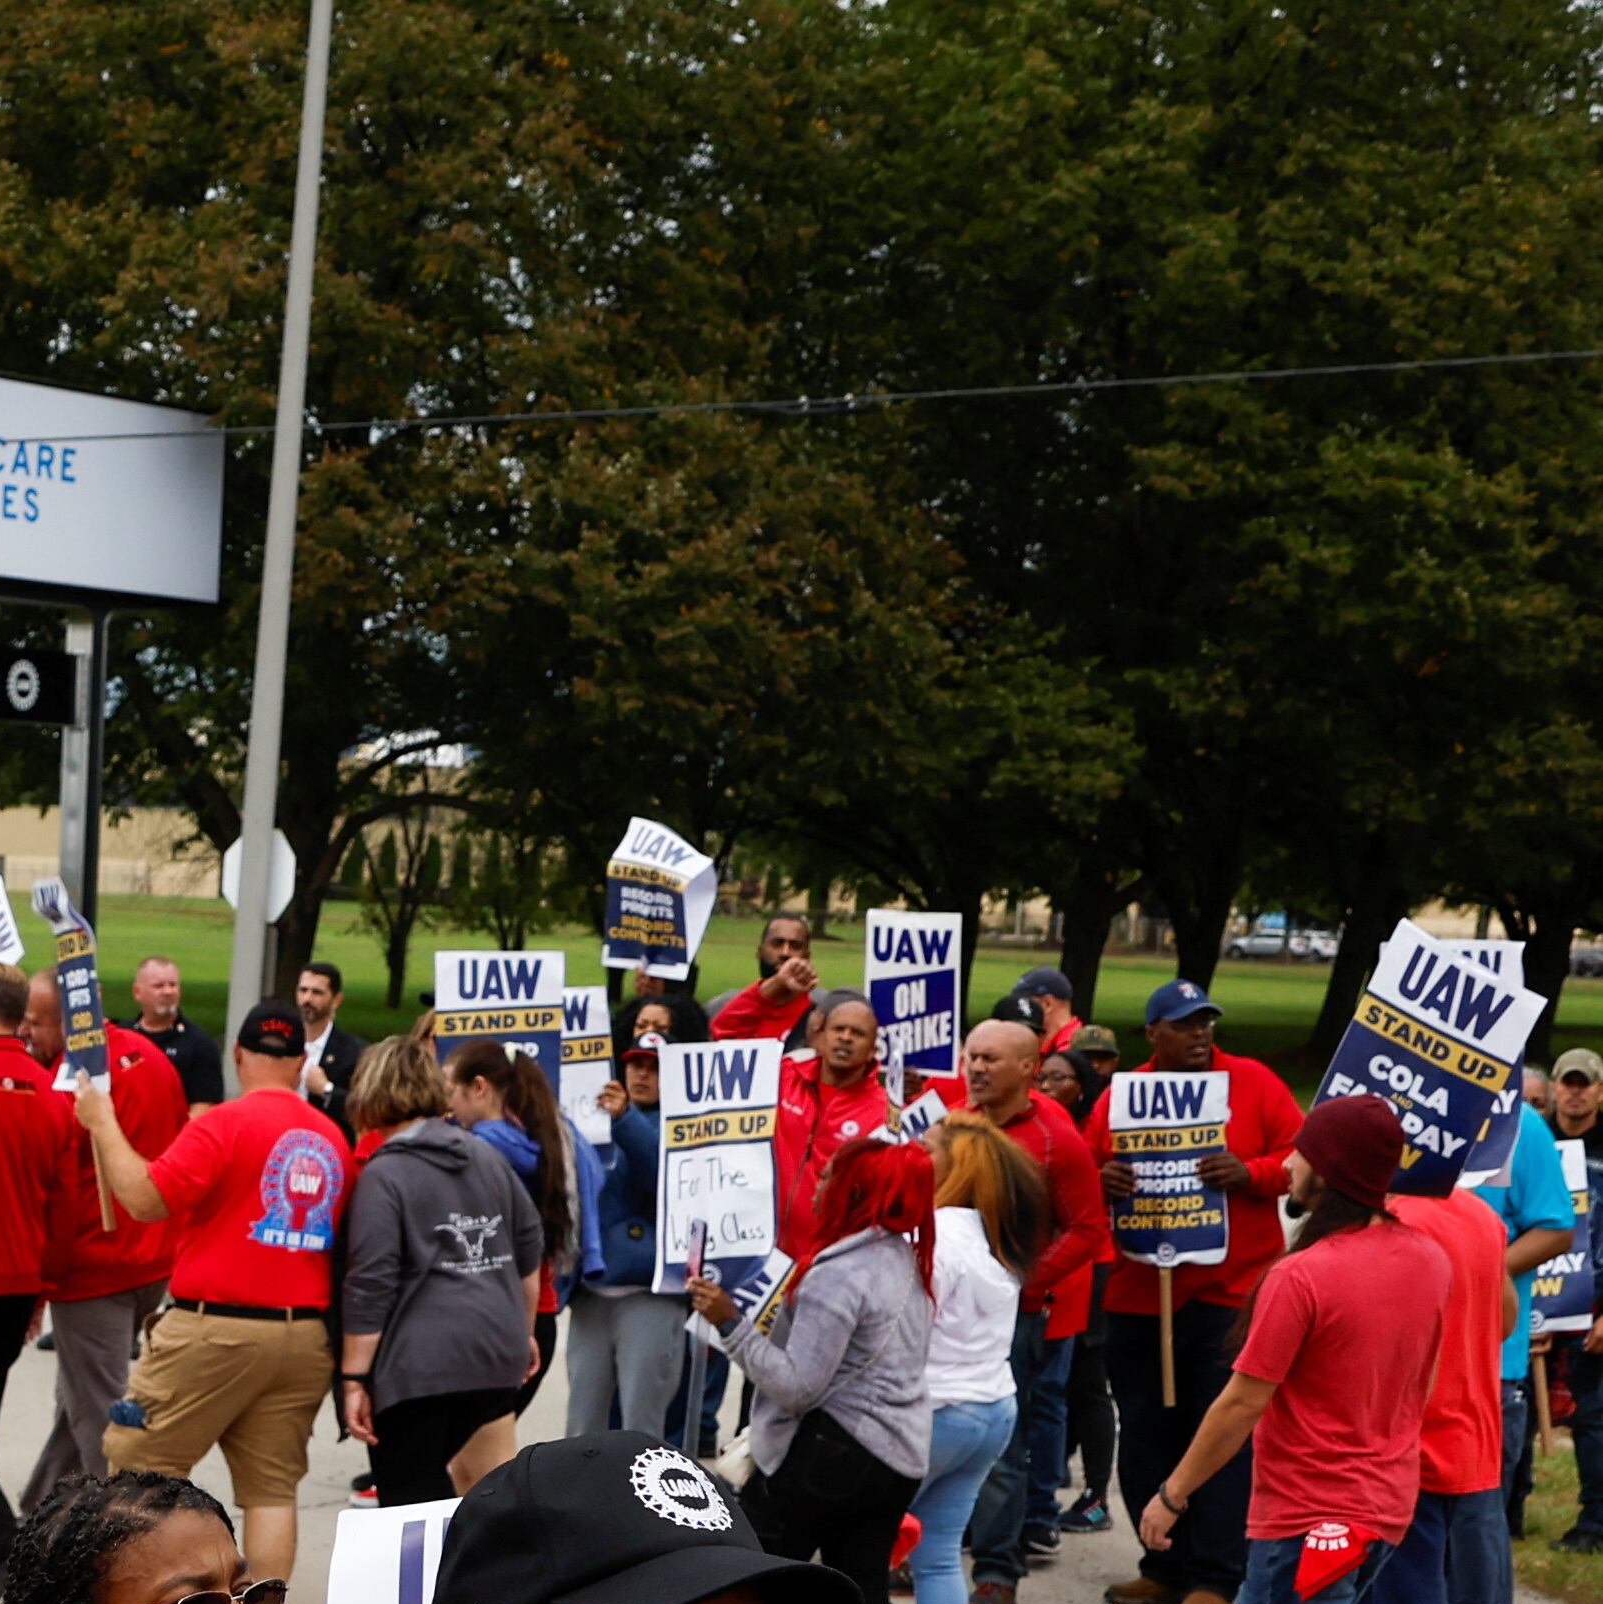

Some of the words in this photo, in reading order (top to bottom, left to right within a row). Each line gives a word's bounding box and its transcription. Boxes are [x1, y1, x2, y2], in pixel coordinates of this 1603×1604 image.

[631, 826, 694, 867] UAW
[612, 864, 660, 882] STAND
[873, 926, 952, 966] UAW
[458, 959, 542, 1000] UAW
[894, 979, 927, 1020] ON
[1398, 944, 1515, 1041] UAW
[444, 1013, 516, 1032] STAND
[524, 1011, 554, 1027] UP
[876, 1011, 952, 1061] STRIKE
[580, 1041, 606, 1056] UP
[1364, 1004, 1450, 1062] STAND
[1457, 1060, 1498, 1089] UP
[683, 1049, 758, 1102] UAW
[1367, 1054, 1450, 1116] COLA
[1128, 1080, 1207, 1120] UAW
[673, 1118, 729, 1143] STAND
[739, 1116, 767, 1134] UP
[1116, 1131, 1182, 1150] STAND
[1190, 1129, 1219, 1145] UP
[706, 1156, 748, 1194] The
[1117, 1208, 1222, 1229] CONTRACTS
[1133, 1195, 1204, 1213] RECORD
[660, 1478, 706, 1499] UAW
